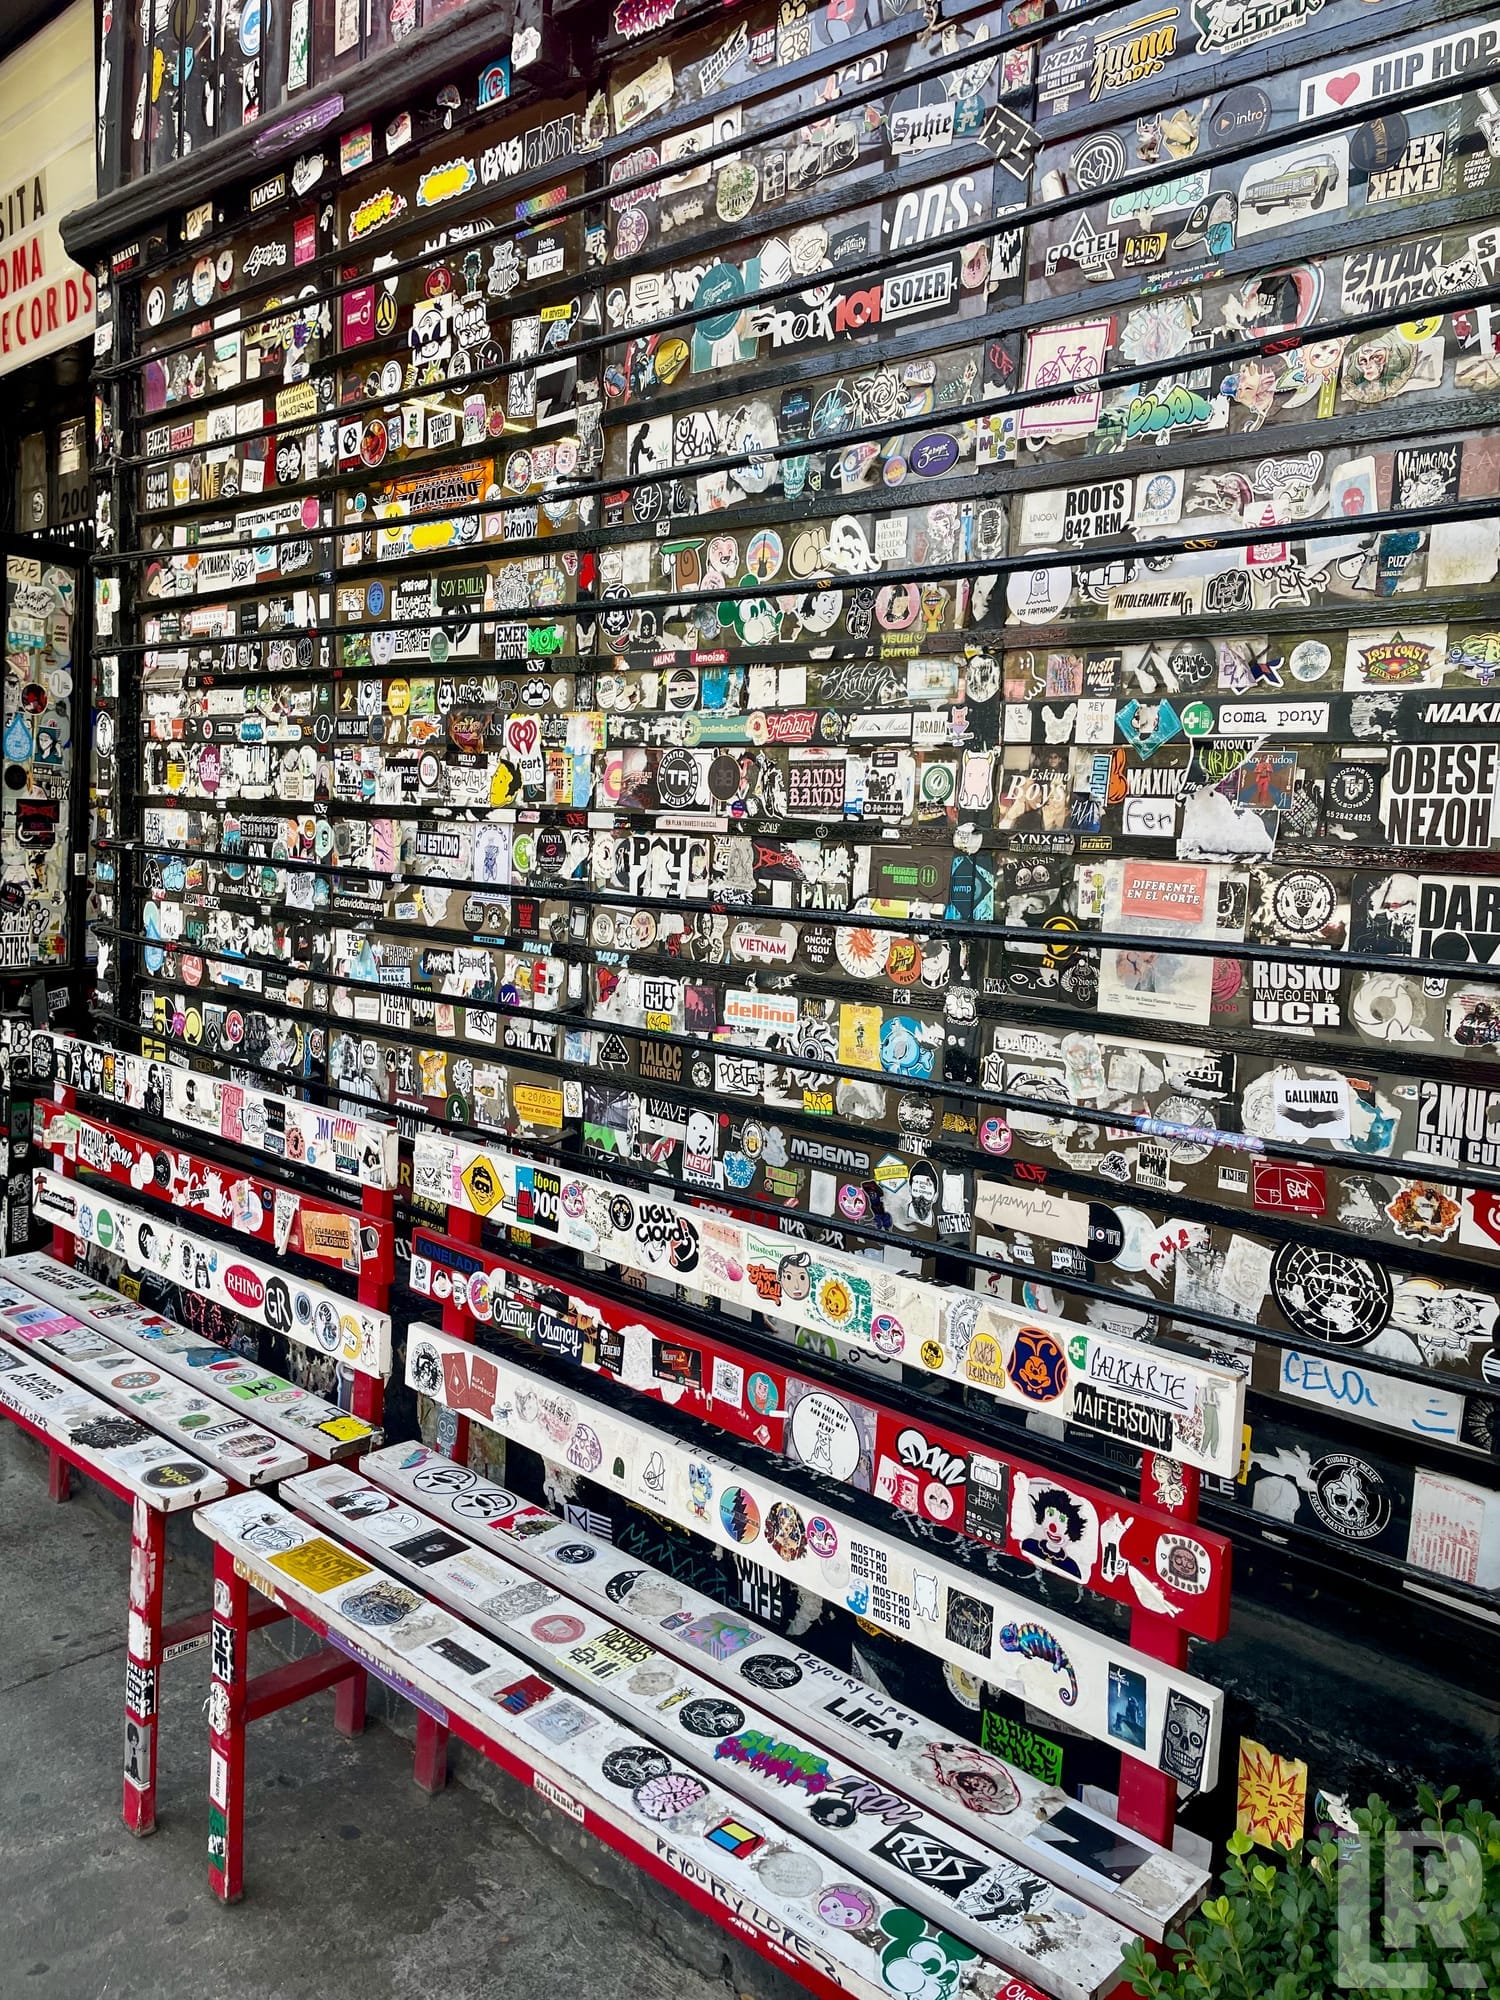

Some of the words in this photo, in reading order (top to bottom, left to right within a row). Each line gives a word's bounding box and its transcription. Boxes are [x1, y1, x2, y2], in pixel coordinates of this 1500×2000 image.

[751, 29, 775, 48] TOP
[751, 41, 775, 60] CREW
[1089, 26, 1176, 102] juana
[1306, 84, 1316, 117] I
[1372, 53, 1424, 97] HIP
[1431, 30, 1498, 76] HOP
[1114, 62, 1151, 87] LADY
[1464, 157, 1491, 168] GENIUS
[1464, 164, 1492, 176] SWITCH
[1468, 179, 1485, 189] OFF!
[1478, 171, 1490, 179] NO
[537, 237, 555, 249] Hello
[1048, 231, 1118, 264] COCTEL
[1345, 234, 1441, 292] SITAR
[638, 282, 654, 292] WHY
[889, 271, 947, 308] SOZER
[431, 412, 452, 433] STONED
[432, 428, 450, 446] CACTI
[397, 479, 484, 507] MEXICANO
[1065, 482, 1125, 517] ROOTS
[266, 505, 291, 524] METHOD
[504, 520, 538, 538] DROIDY
[1065, 519, 1090, 541] 842
[1094, 514, 1122, 536] REM
[440, 579, 457, 597] SOY
[457, 576, 484, 594] EMILIA
[1114, 593, 1170, 609] INTOLERANTE
[1171, 591, 1187, 606] MX
[1016, 609, 1026, 617] LOS
[496, 625, 528, 642] EMEK
[881, 633, 914, 645] visual
[653, 652, 676, 666] MUNX
[695, 652, 725, 663] lenoize
[880, 645, 919, 659] journal
[1366, 645, 1393, 663] LOST
[1394, 643, 1429, 661] COAST
[1086, 658, 1114, 675] INSTA
[1088, 702, 1105, 711] REY
[1222, 710, 1267, 724] coma
[1277, 707, 1324, 728] pony
[1213, 739, 1244, 750] KNOW
[457, 755, 477, 763] HELLO
[667, 771, 691, 785] TR
[789, 767, 845, 788] BANDY
[1028, 768, 1072, 783] Eskimo
[1392, 745, 1497, 795] OBESE
[789, 787, 845, 807] BANDY
[1005, 774, 1069, 808] Boys
[241, 820, 278, 837] SAMMY
[1387, 796, 1492, 847] NEZOH
[428, 835, 459, 855] ESTUDIO
[541, 834, 563, 844] VINYL
[952, 884, 972, 895] wmp
[1132, 879, 1196, 894] DIFERENTE
[1127, 889, 1143, 899] EN
[1145, 890, 1160, 900] EL
[1161, 890, 1201, 906] NORTE
[738, 937, 788, 956] VIETNAM
[804, 936, 833, 945] ONCOC
[807, 945, 830, 954] KSOU
[811, 955, 825, 964] ND.
[382, 973, 405, 982] KILLS
[1255, 988, 1300, 1002] NAVEGO
[1303, 989, 1319, 1002] EN
[387, 1009, 406, 1027] DIET
[726, 1000, 796, 1022] delfino
[1252, 1001, 1341, 1026] UCR
[640, 1041, 683, 1068] TALOC
[640, 1064, 682, 1082] INIKREW
[1285, 1089, 1338, 1105] GALLINAZO
[650, 1100, 687, 1124] WAVE
[334, 1116, 357, 1143] HIGH
[1417, 1132, 1460, 1161] REM
[686, 1154, 712, 1172] NEW
[533, 1170, 559, 1194] ibero
[639, 1203, 676, 1224] UGLY
[937, 1214, 972, 1233] MOSTRO
[226, 1271, 264, 1301] RHINO
[1275, 1269, 1353, 1298] LOYALTY
[1359, 1289, 1389, 1306] MX
[266, 1289, 291, 1325] GR
[810, 1397, 822, 1409] WHO
[823, 1402, 835, 1415] SAID
[836, 1410, 849, 1424] ROCK
[810, 1407, 821, 1418] AND
[821, 1413, 834, 1426] ROLL
[834, 1421, 847, 1433] WAS
[818, 1420, 835, 1435] DEAD?
[1325, 1456, 1348, 1467] CIUDAD
[1325, 1515, 1346, 1535] HASTA
[1356, 1524, 1381, 1537] MUERTE
[850, 1541, 888, 1563] MOSTRO
[850, 1552, 888, 1574] MOSTRO
[850, 1564, 888, 1585] MOSTRO
[872, 1585, 910, 1607] MOSTRO
[872, 1596, 910, 1618] MOSTRO
[872, 1608, 911, 1630] MOSTRO
[823, 1696, 906, 1750] LIFA
